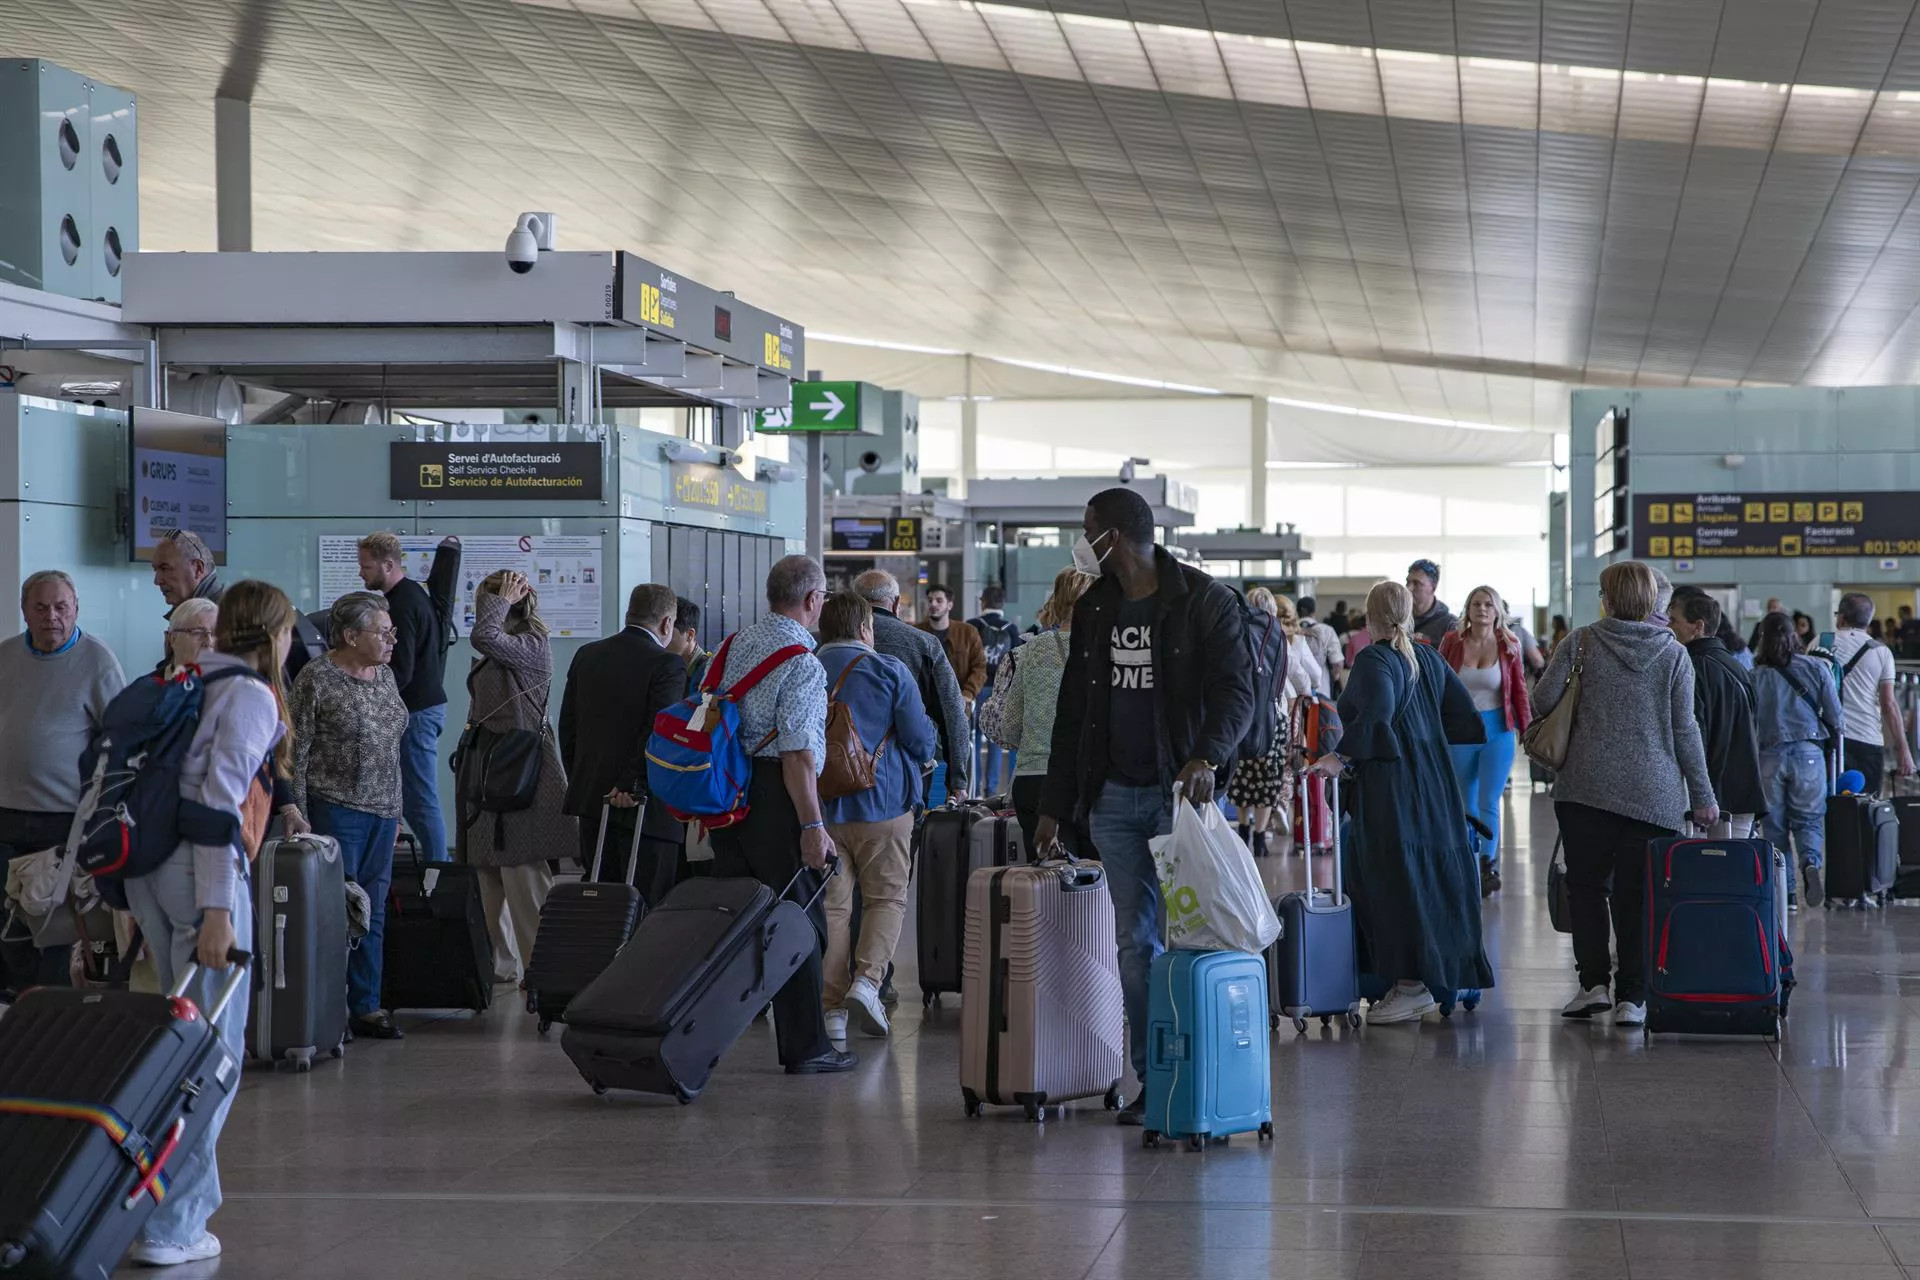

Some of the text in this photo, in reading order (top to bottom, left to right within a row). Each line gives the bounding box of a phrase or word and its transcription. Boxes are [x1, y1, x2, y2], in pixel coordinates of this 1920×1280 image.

[605, 310, 612, 320] SE
[448, 453, 561, 463] Servei d'Autofacturació
[150, 462, 176, 480] GRUPS
[448, 465, 536, 474] Self Service Check-in
[448, 476, 583, 486] Servicio de Autofacturación
